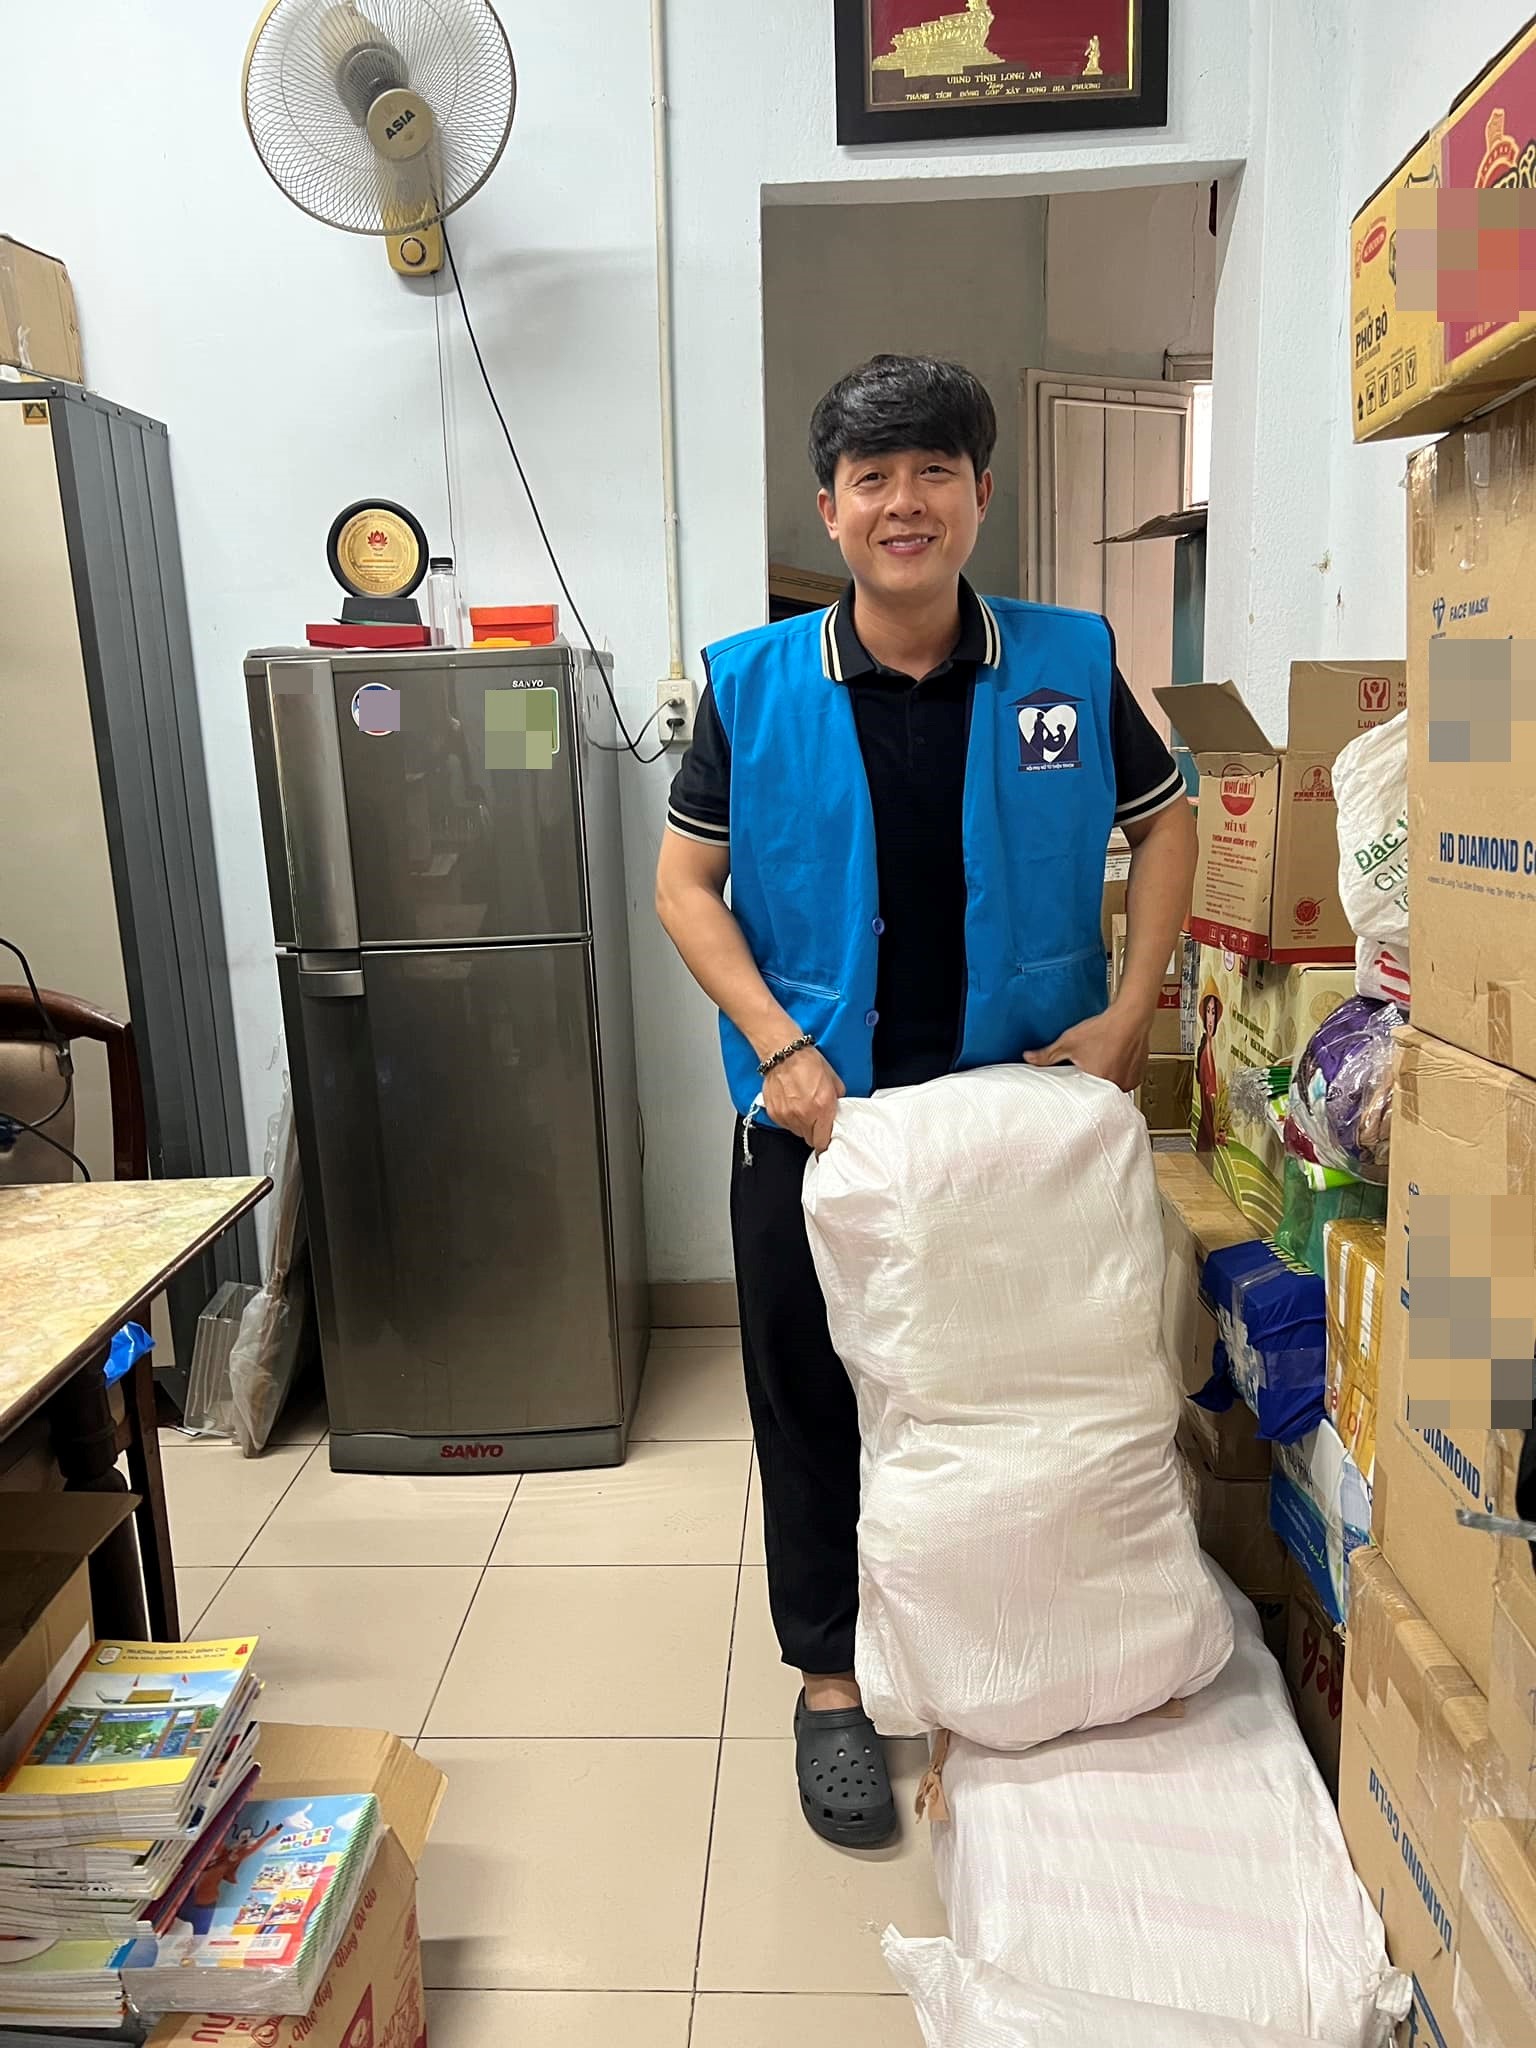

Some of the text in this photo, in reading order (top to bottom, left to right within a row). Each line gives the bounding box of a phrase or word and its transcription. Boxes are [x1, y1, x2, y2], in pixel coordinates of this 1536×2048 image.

[1001, 73, 1024, 82] LONG
[1029, 72, 1042, 80] AN
[385, 109, 416, 140] ASIA
[1355, 316, 1373, 358] PHỞ
[1449, 603, 1467, 621] FACE
[1468, 596, 1489, 615] MASK
[512, 680, 544, 688] SANYO
[1440, 831, 1454, 863] HD
[1458, 834, 1518, 872] DIAMOND
[440, 1444, 503, 1458] SANYO
[280, 1835, 328, 1851] MOUSE
[1402, 1832, 1452, 1953] DIAMOND
